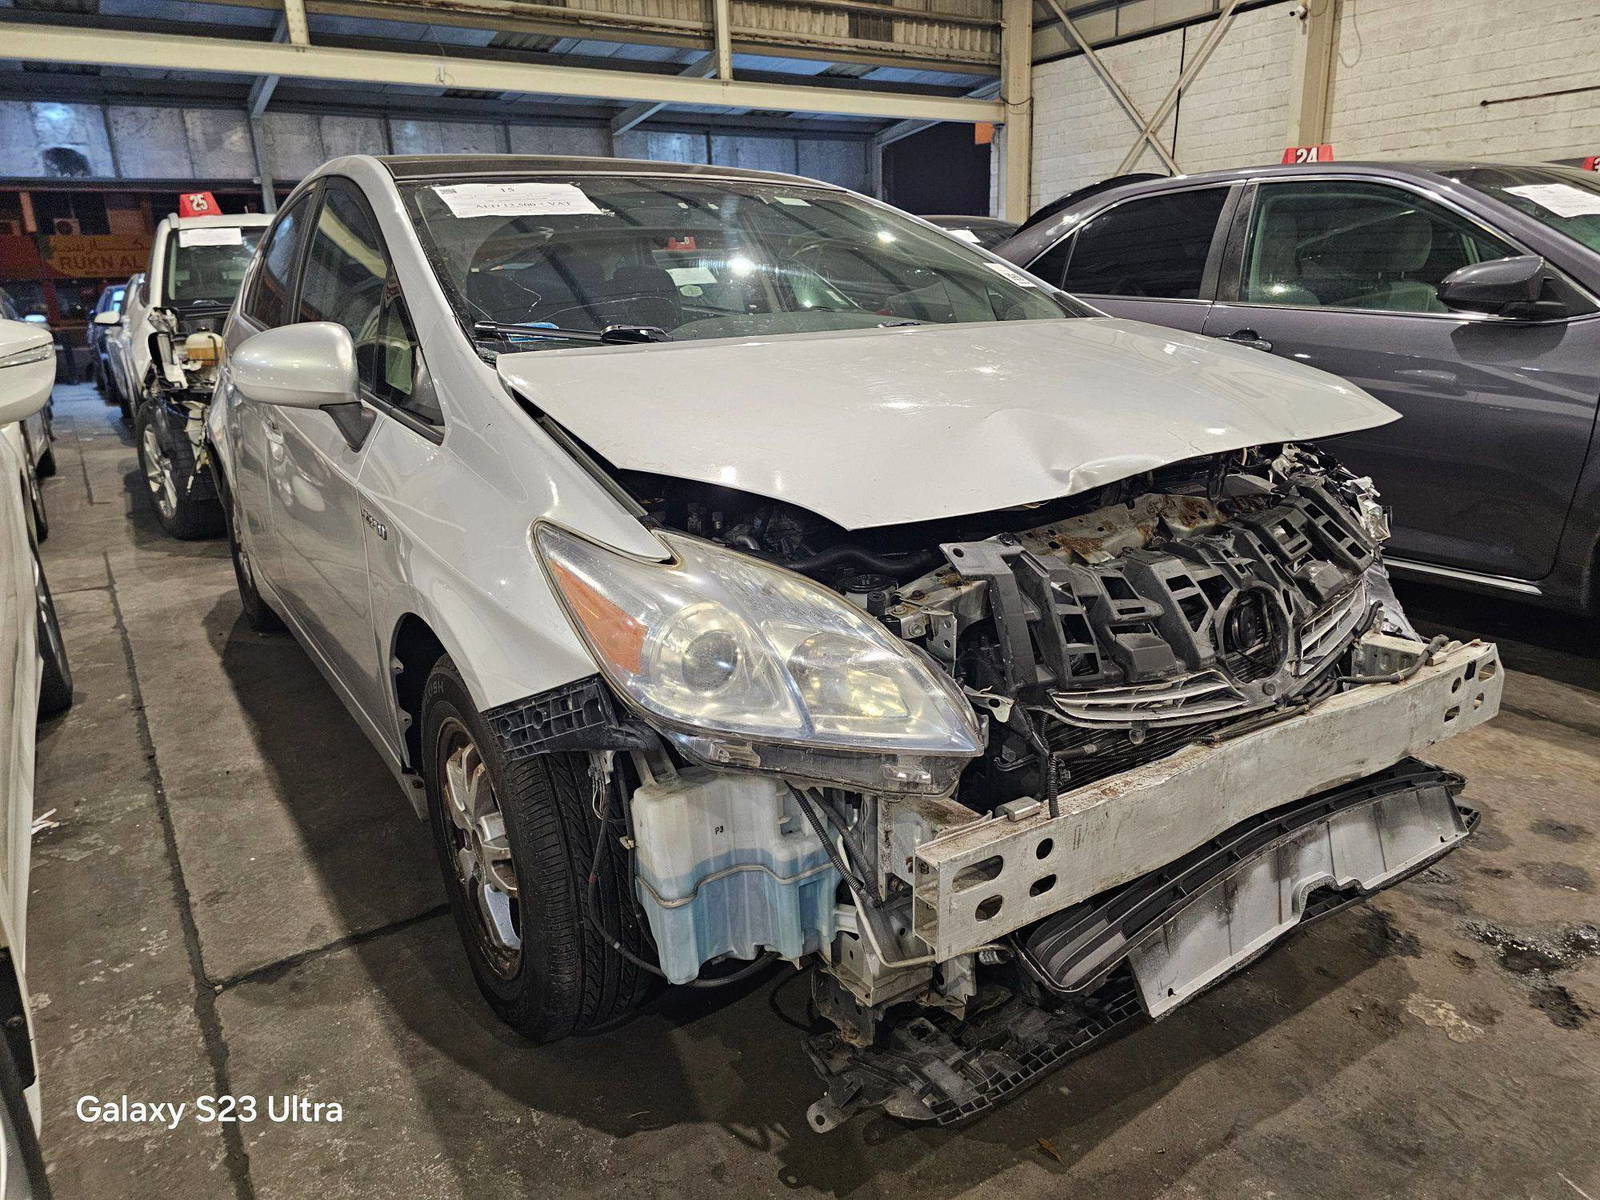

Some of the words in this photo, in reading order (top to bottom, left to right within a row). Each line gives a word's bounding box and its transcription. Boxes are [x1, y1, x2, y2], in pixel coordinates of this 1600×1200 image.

[1296, 147, 1318, 164] 24
[189, 194, 208, 211] 25
[60, 256, 113, 269] RUKN
